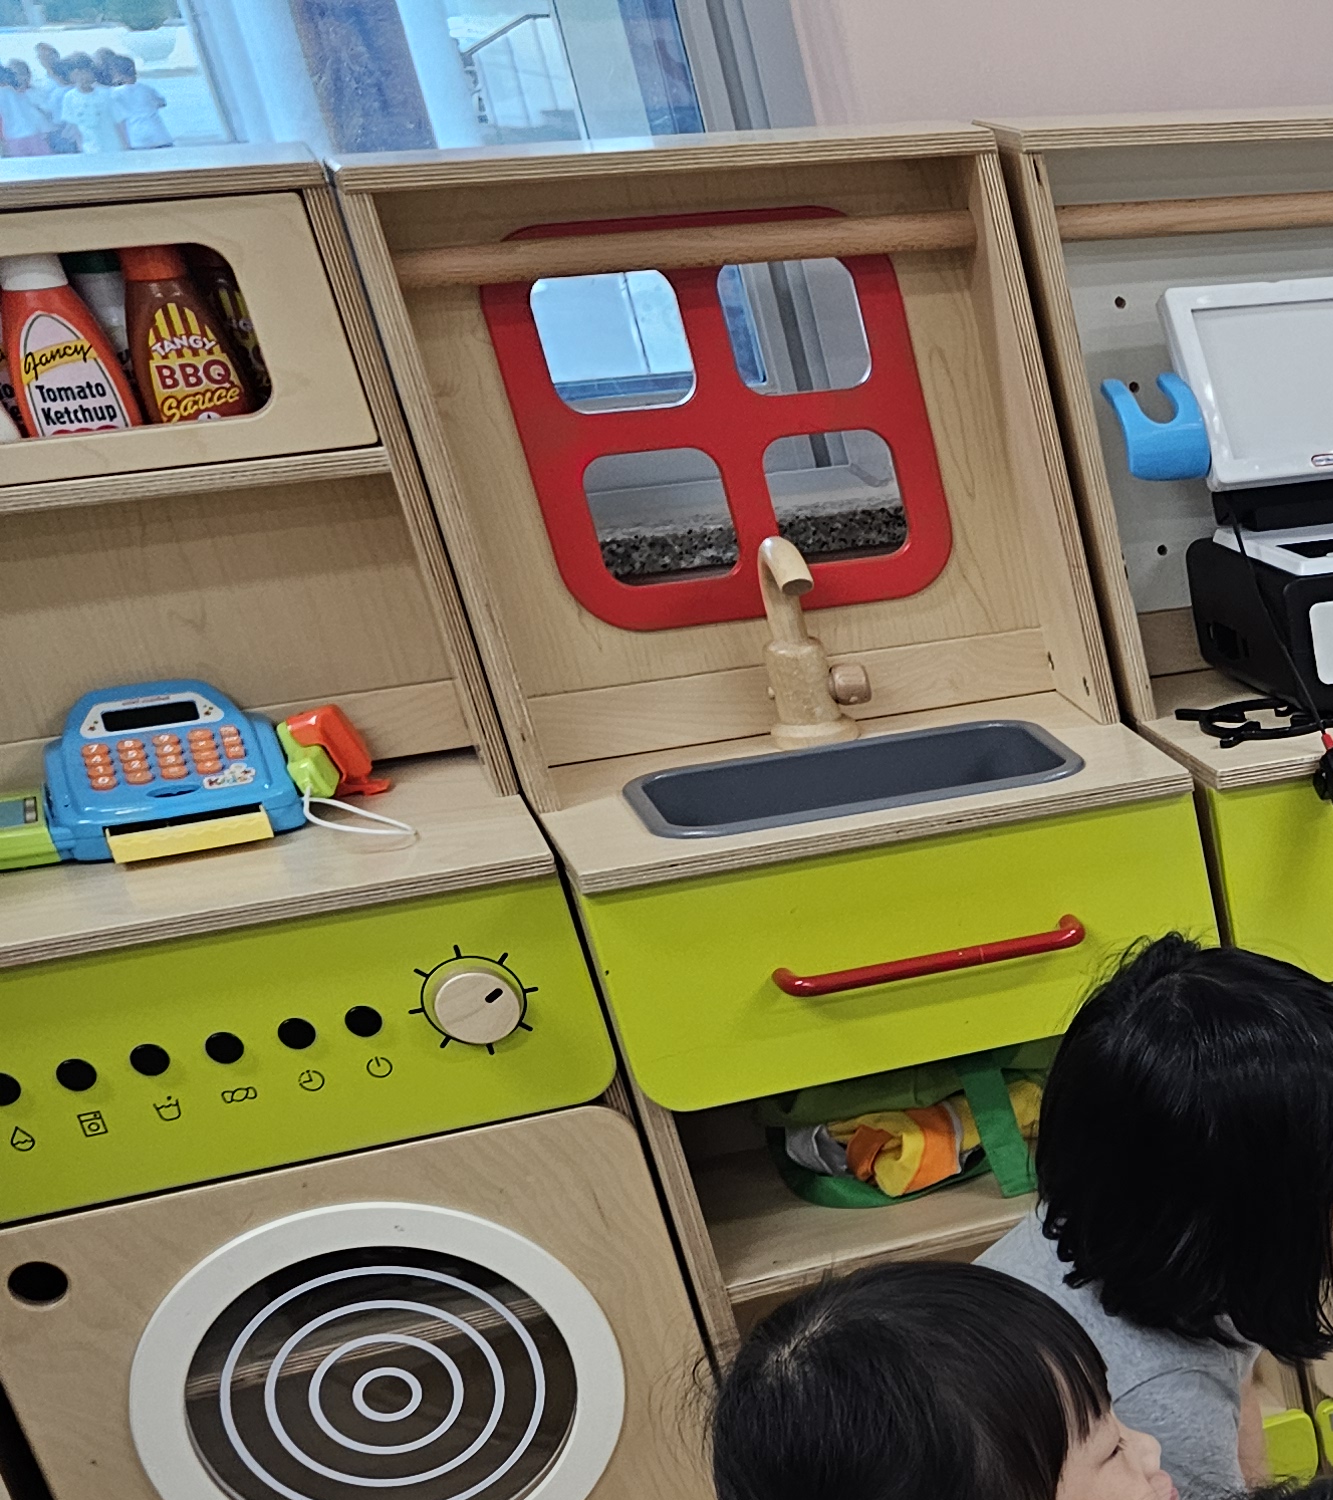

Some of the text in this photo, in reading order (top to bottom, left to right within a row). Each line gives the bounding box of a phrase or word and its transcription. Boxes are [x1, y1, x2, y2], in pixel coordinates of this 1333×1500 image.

[151, 335, 216, 356] TANGY
[23, 344, 93, 380] Fancy
[155, 359, 236, 389] BBQ
[35, 381, 106, 403] Tomato
[41, 405, 117, 426] Ketchup
[162, 387, 240, 424] Sauce
